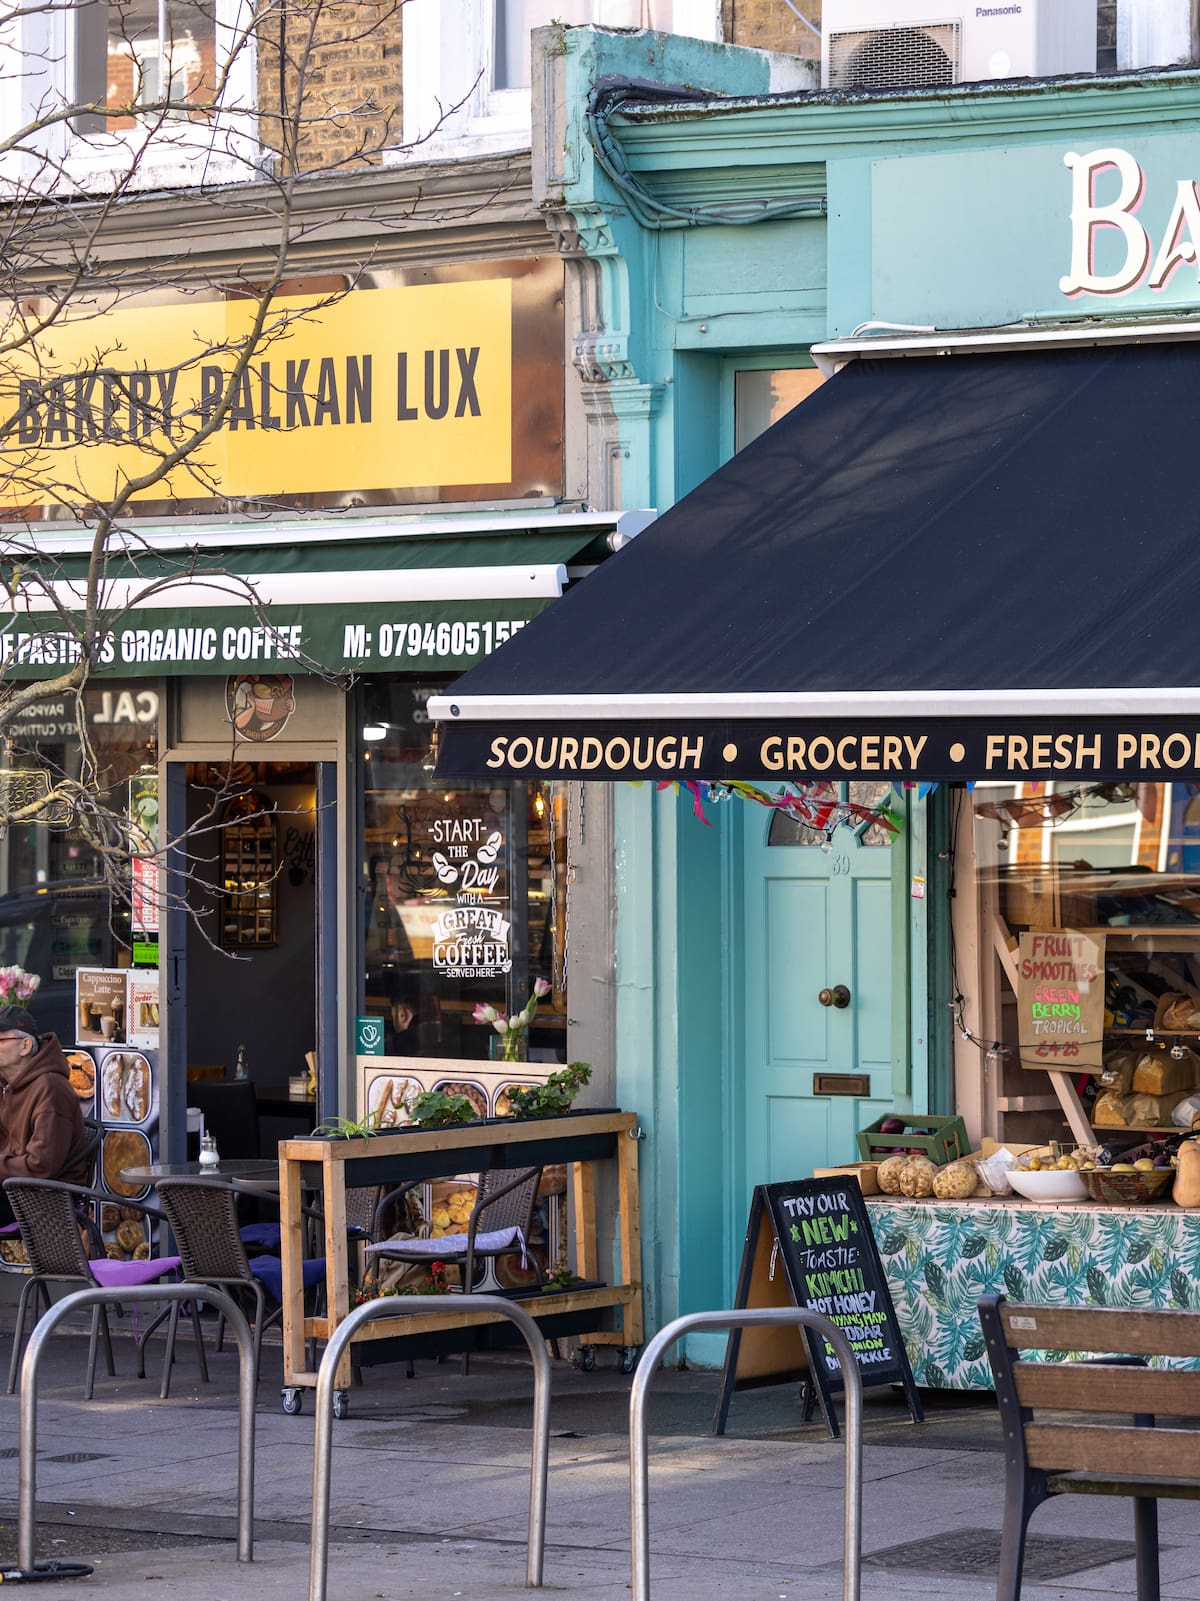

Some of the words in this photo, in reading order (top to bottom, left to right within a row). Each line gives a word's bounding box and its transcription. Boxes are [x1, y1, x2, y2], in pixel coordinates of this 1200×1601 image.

[976, 4, 1022, 16] Panasonic
[19, 369, 179, 444] BAKERY
[201, 354, 372, 432] BALKAN
[398, 347, 481, 421] LUX
[18, 630, 115, 665] PASTRS
[121, 627, 217, 663] ORGANIC
[222, 625, 302, 661] COFFEE
[343, 624, 372, 658] M:
[486, 736, 704, 771] SOURDOUGH
[760, 736, 928, 771] GROCERY
[985, 734, 1101, 769] FRESH
[448, 845, 469, 858] THE
[461, 860, 499, 894] Day
[456, 893, 475, 905] WITH
[442, 908, 498, 931] GREAT
[455, 929, 486, 948] Fresh
[1032, 934, 1087, 957] FRUIT
[434, 943, 508, 966] COFFEE
[82, 973, 122, 985] Cappuccino
[446, 967, 475, 978] SERVED
[476, 967, 496, 978] HERE
[1021, 959, 1097, 982] SMOOTHIES
[94, 984, 112, 994] Latte
[1032, 1001, 1081, 1021] BERRY
[1032, 1020, 1088, 1035] TROPICAL
[784, 1195, 815, 1218] TRY
[817, 1192, 850, 1215] OUR
[801, 1214, 849, 1246] NEW
[801, 1247, 857, 1269] TOASTIE
[805, 1267, 866, 1299] KIMCHI
[806, 1297, 833, 1315] HOT
[833, 1290, 876, 1315] HONEY
[862, 1312, 888, 1326] MAYO
